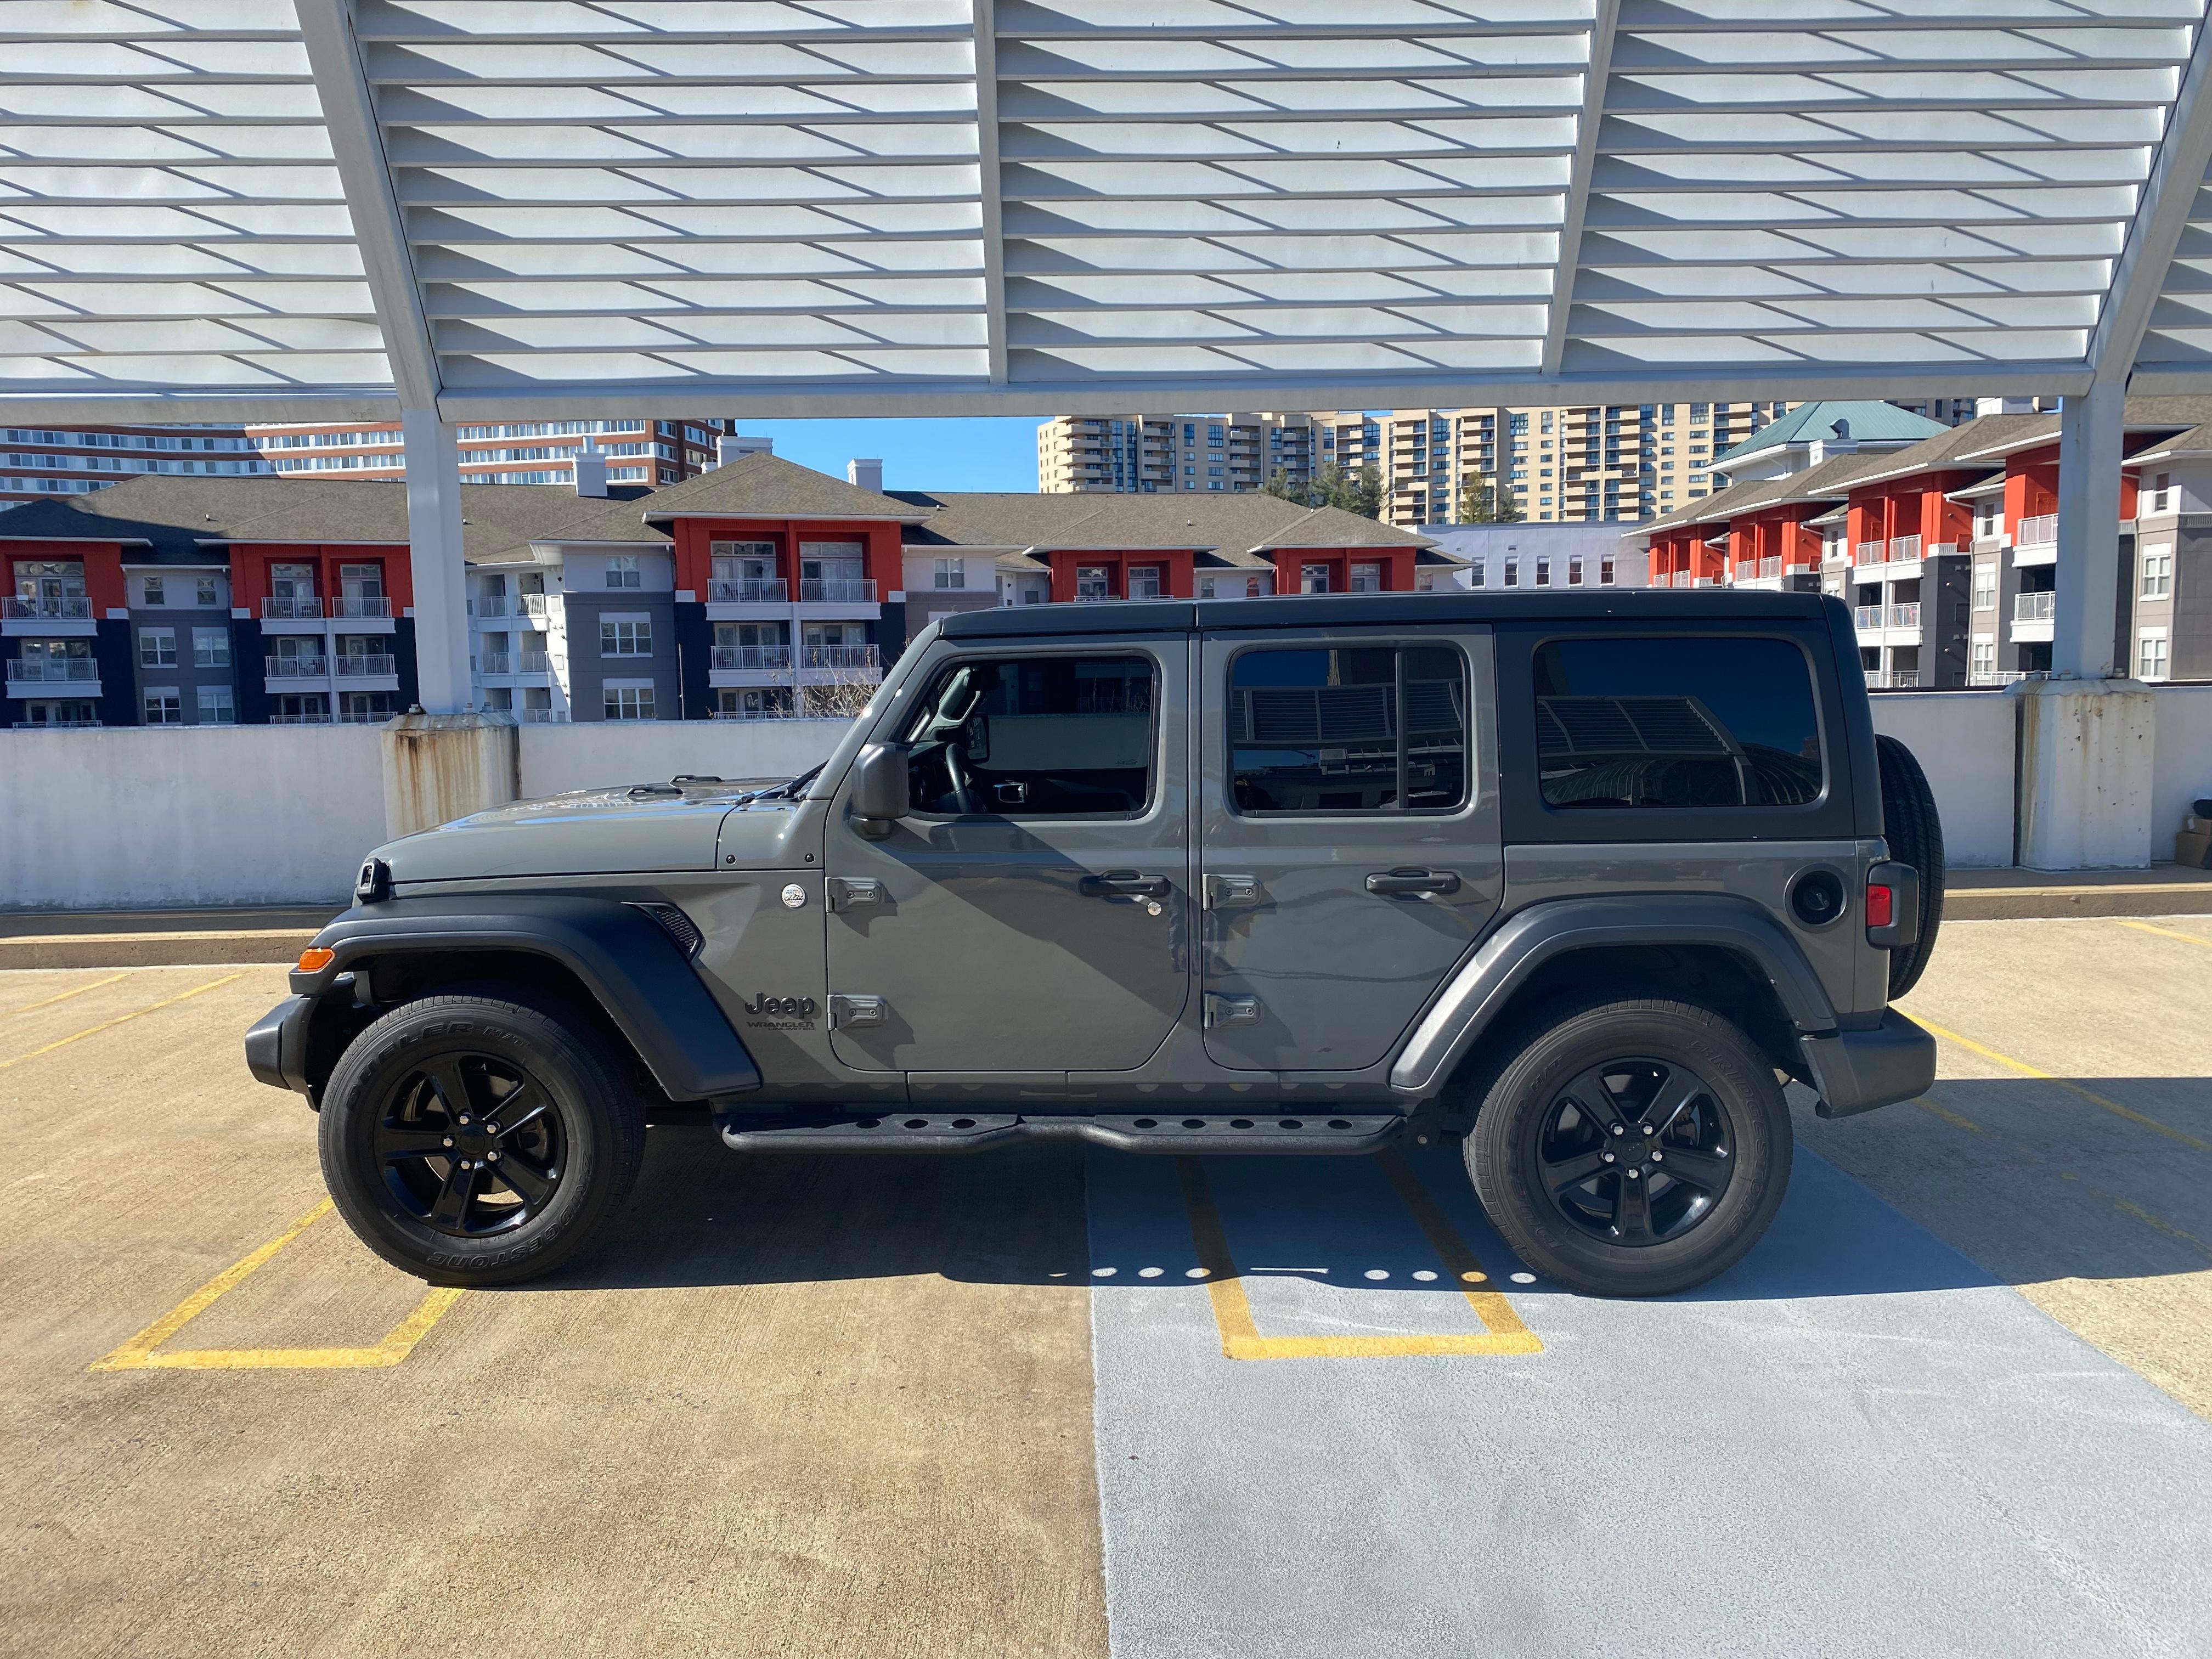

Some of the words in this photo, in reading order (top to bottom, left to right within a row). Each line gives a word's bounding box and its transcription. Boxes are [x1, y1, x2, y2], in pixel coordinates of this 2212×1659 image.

[744, 992, 814, 1019] Jeep
[1685, 1040, 1769, 1233] BRIDGESTONE
[426, 1149, 593, 1269] BRIDGESTONE
